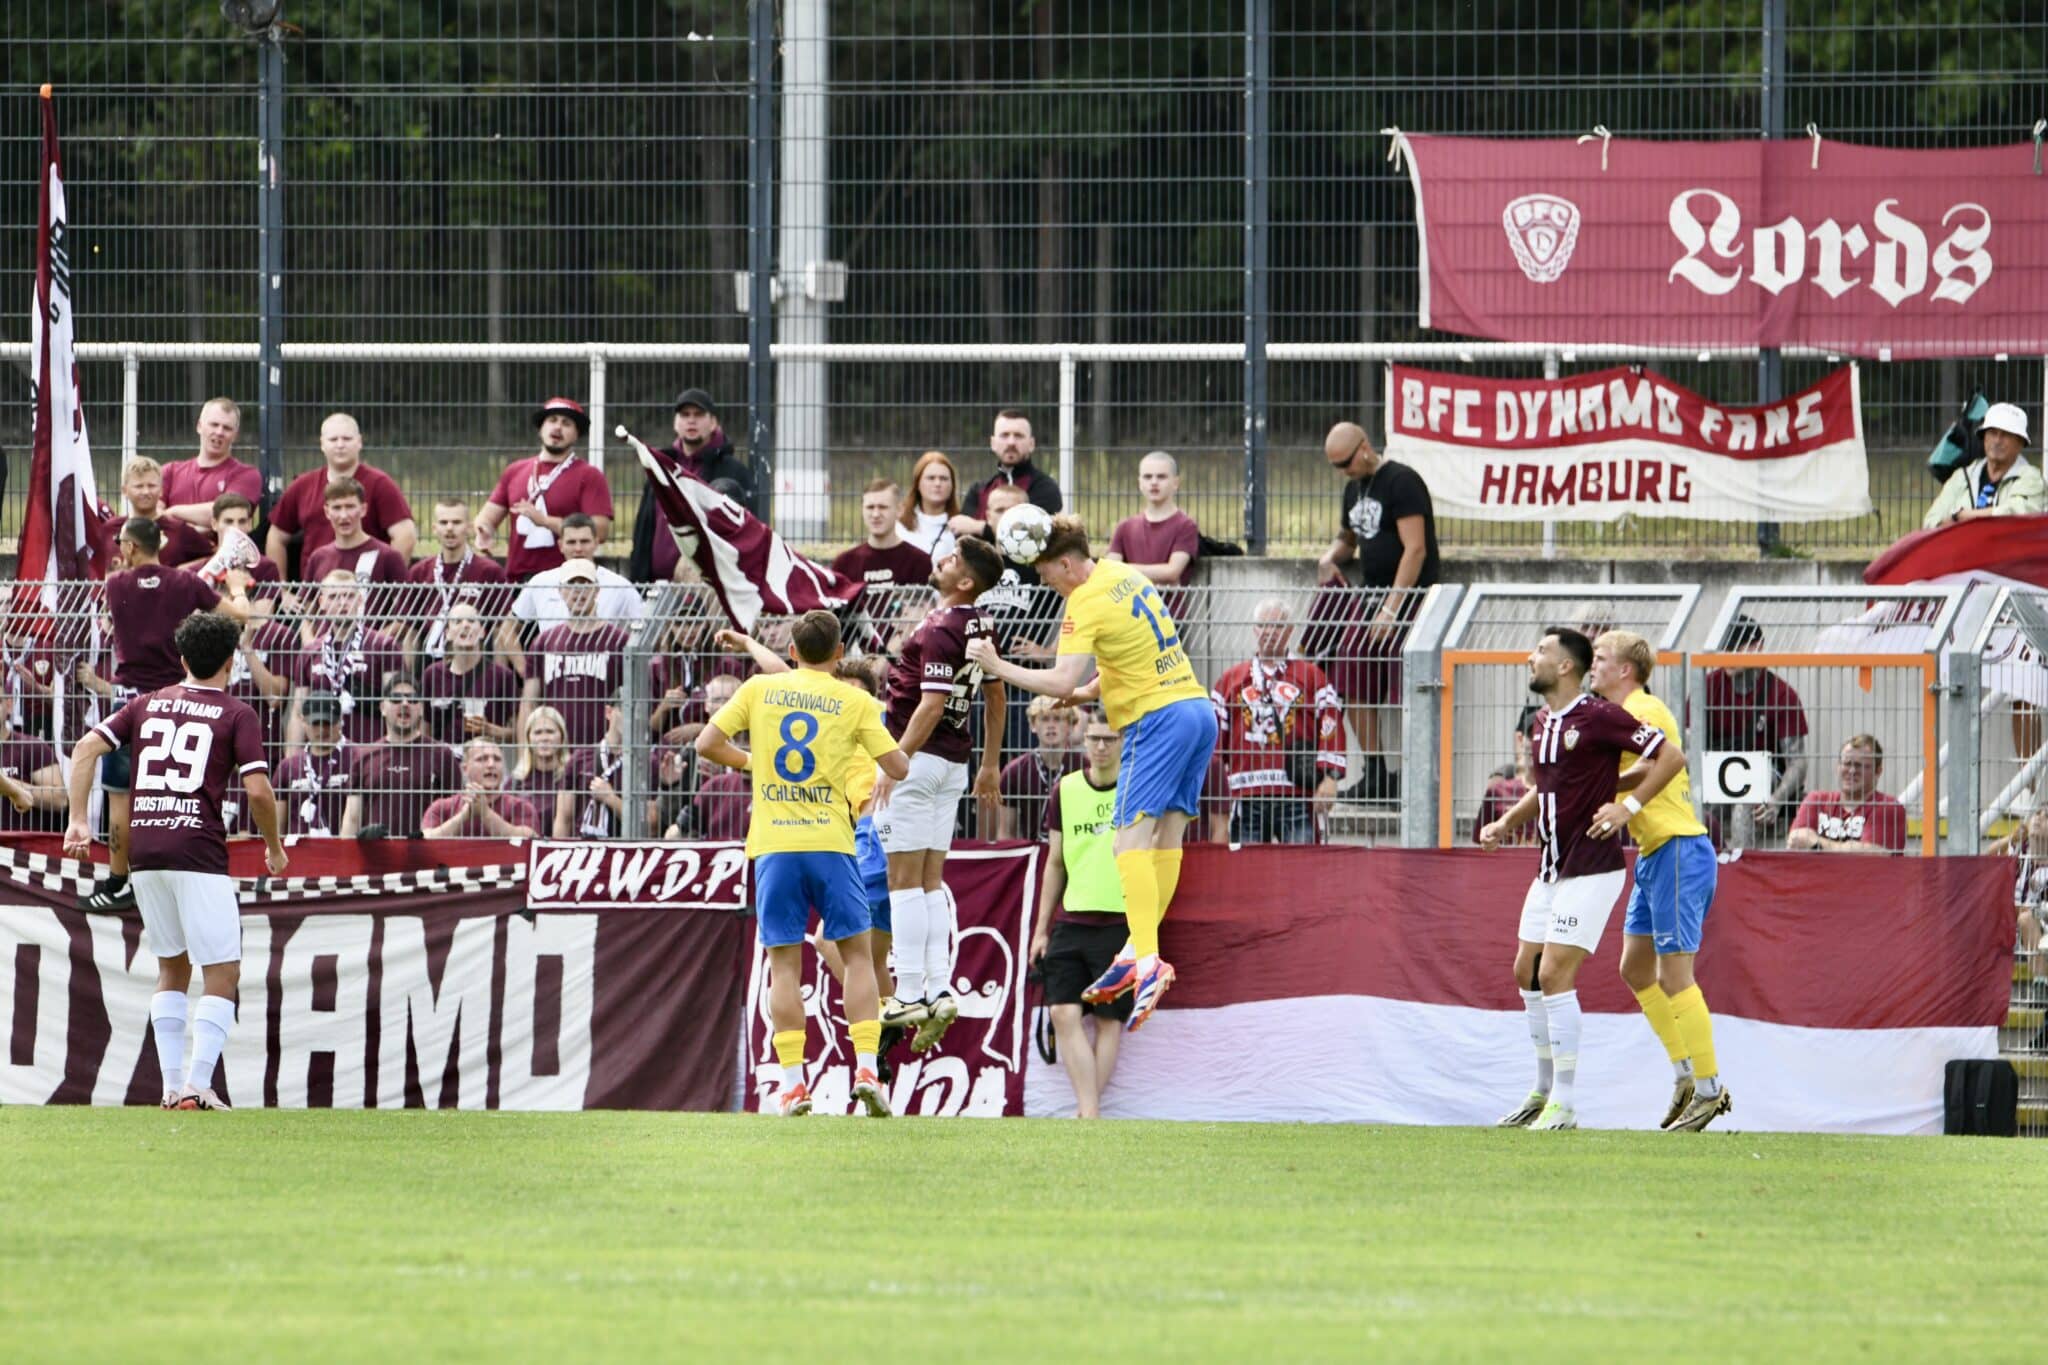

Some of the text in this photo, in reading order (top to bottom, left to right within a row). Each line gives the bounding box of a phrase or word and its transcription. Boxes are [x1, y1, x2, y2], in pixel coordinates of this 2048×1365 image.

[1513, 201, 1570, 228] BFC
[1668, 187, 1994, 309] Lords
[1401, 378, 1824, 451] BFC DYNAMO FANS
[1480, 459, 1691, 505] HAMBURG
[1131, 585, 1178, 653] 13
[924, 662, 953, 677] DWB
[146, 698, 223, 719] BFC DYNAMO
[764, 688, 843, 716] LUCKENWALDE
[135, 717, 214, 793] 29
[774, 711, 819, 783] 8
[761, 783, 832, 804] SCHLEINITZ
[1718, 757, 1752, 798] C
